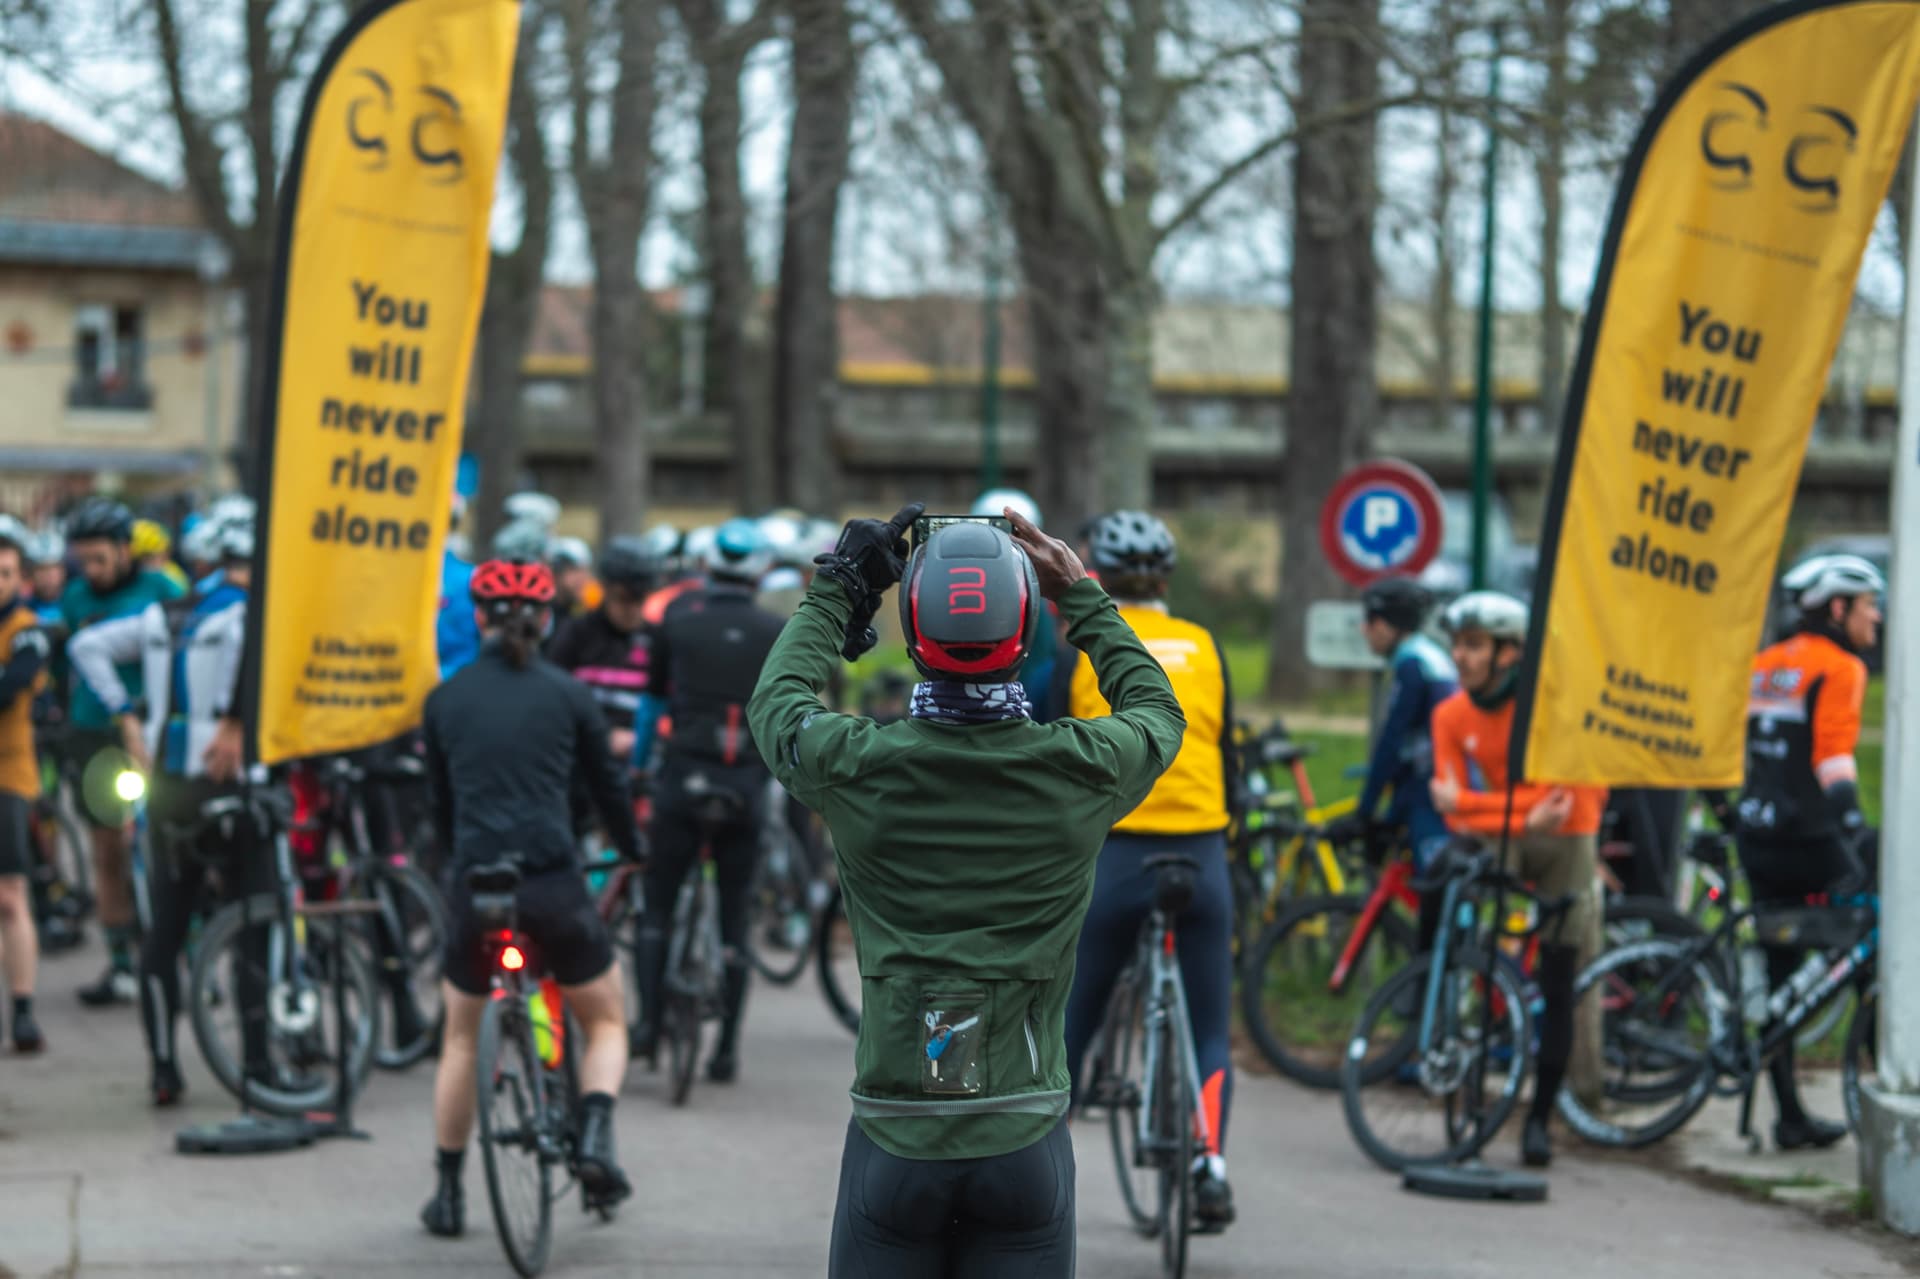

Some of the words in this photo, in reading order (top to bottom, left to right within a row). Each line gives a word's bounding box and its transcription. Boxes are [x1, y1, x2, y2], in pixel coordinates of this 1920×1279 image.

[351, 279, 429, 331] You
[1679, 299, 1762, 364] You
[349, 342, 421, 385] will
[320, 397, 446, 443] never
[1661, 369, 1745, 420] will
[330, 449, 418, 498] ride
[1632, 420, 1752, 481] never
[311, 505, 431, 551] alone
[1364, 496, 1400, 539] P
[1638, 476, 1715, 533] ride
[1611, 532, 1718, 594] alone
